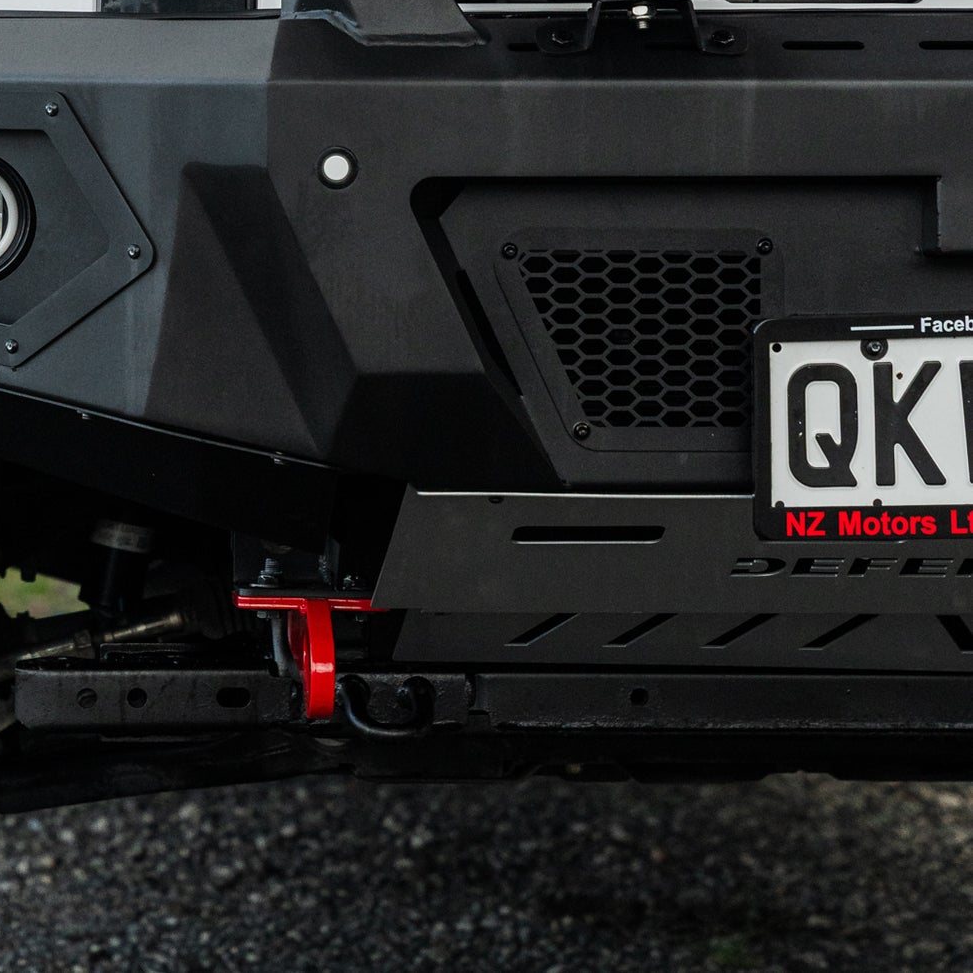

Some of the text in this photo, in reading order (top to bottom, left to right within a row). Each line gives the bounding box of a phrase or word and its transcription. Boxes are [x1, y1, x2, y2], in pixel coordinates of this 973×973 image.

[787, 360, 973, 487] QK
[785, 512, 826, 537] NZ
[838, 511, 937, 537] Motors
